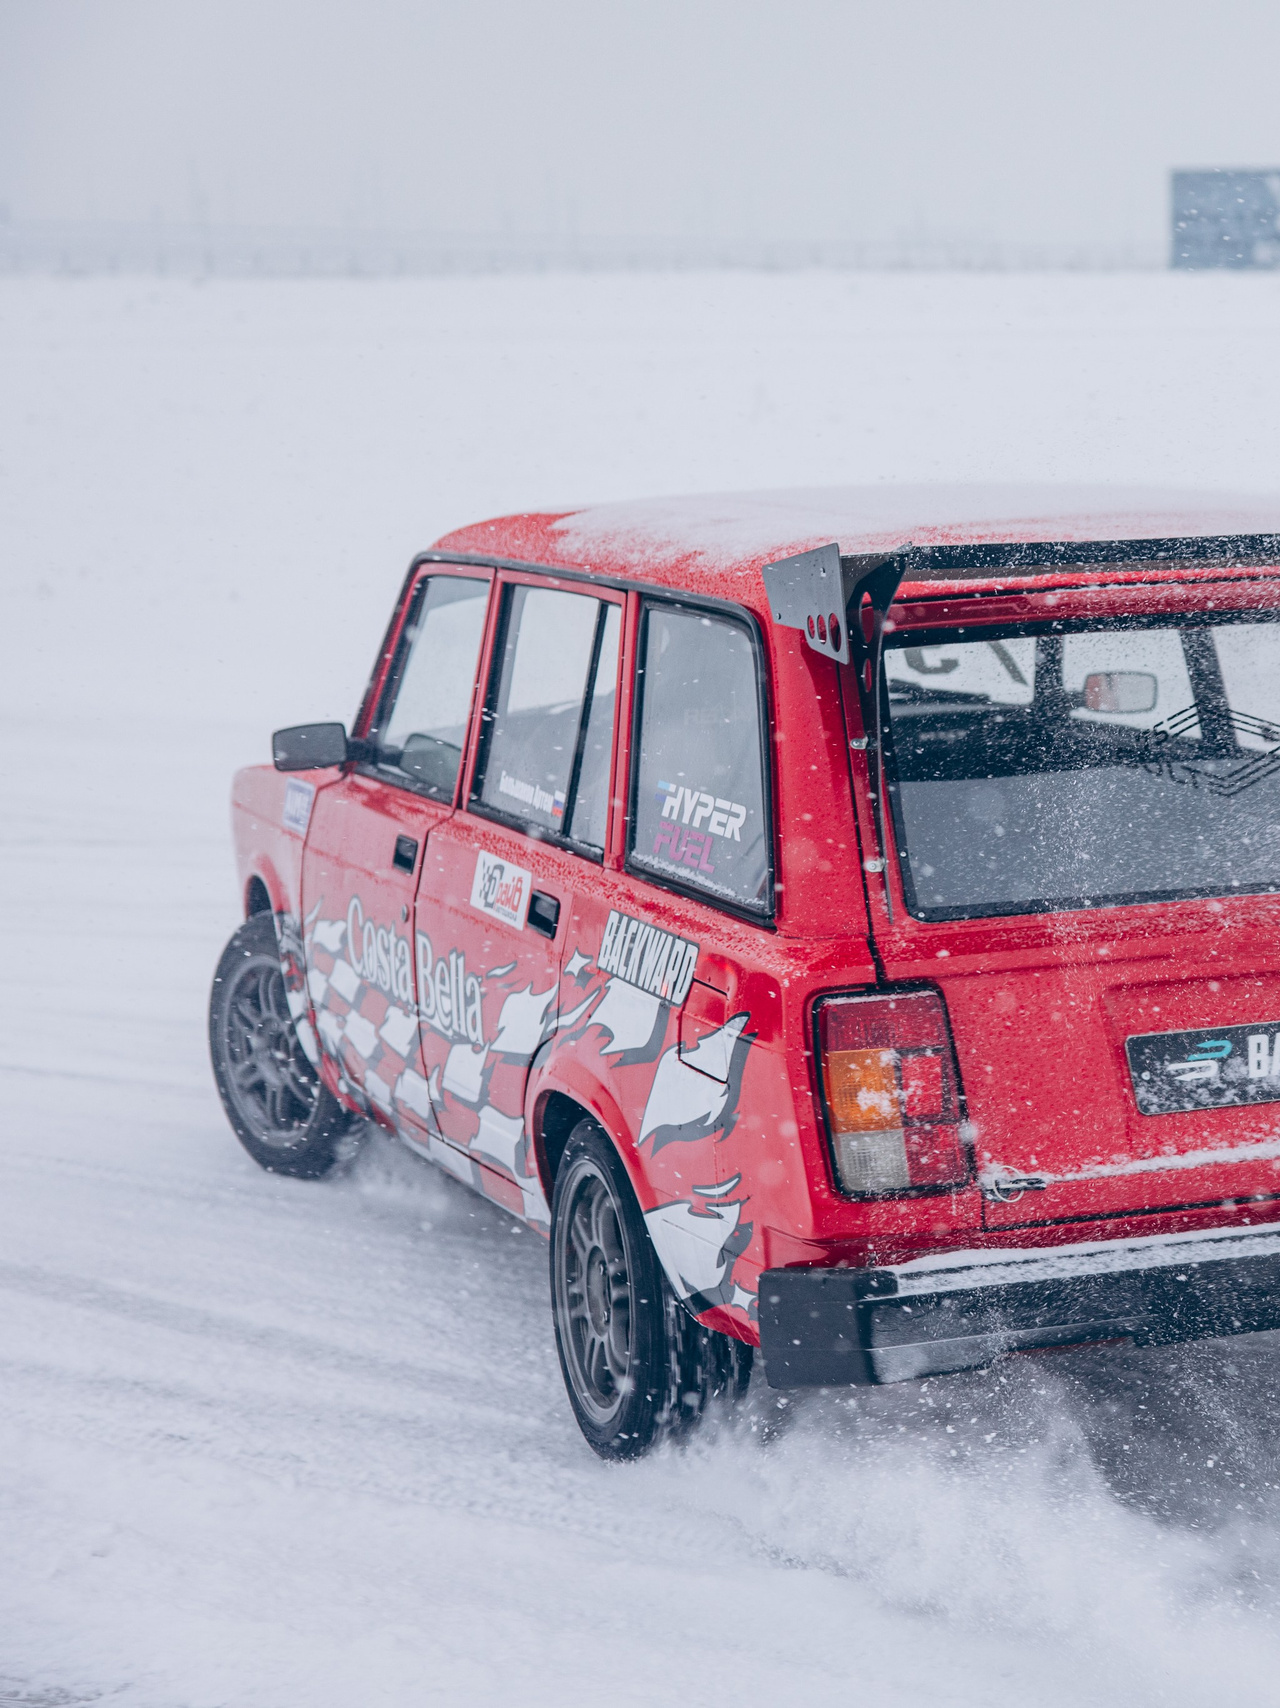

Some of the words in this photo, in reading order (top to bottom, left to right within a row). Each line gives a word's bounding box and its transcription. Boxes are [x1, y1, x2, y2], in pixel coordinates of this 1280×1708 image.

[653, 821, 715, 874] FUEL
[655, 780, 746, 842] HYPER
[347, 894, 415, 1004] Costa
[415, 930, 485, 1045] Bella
[597, 909, 699, 1005] BACKWARD
